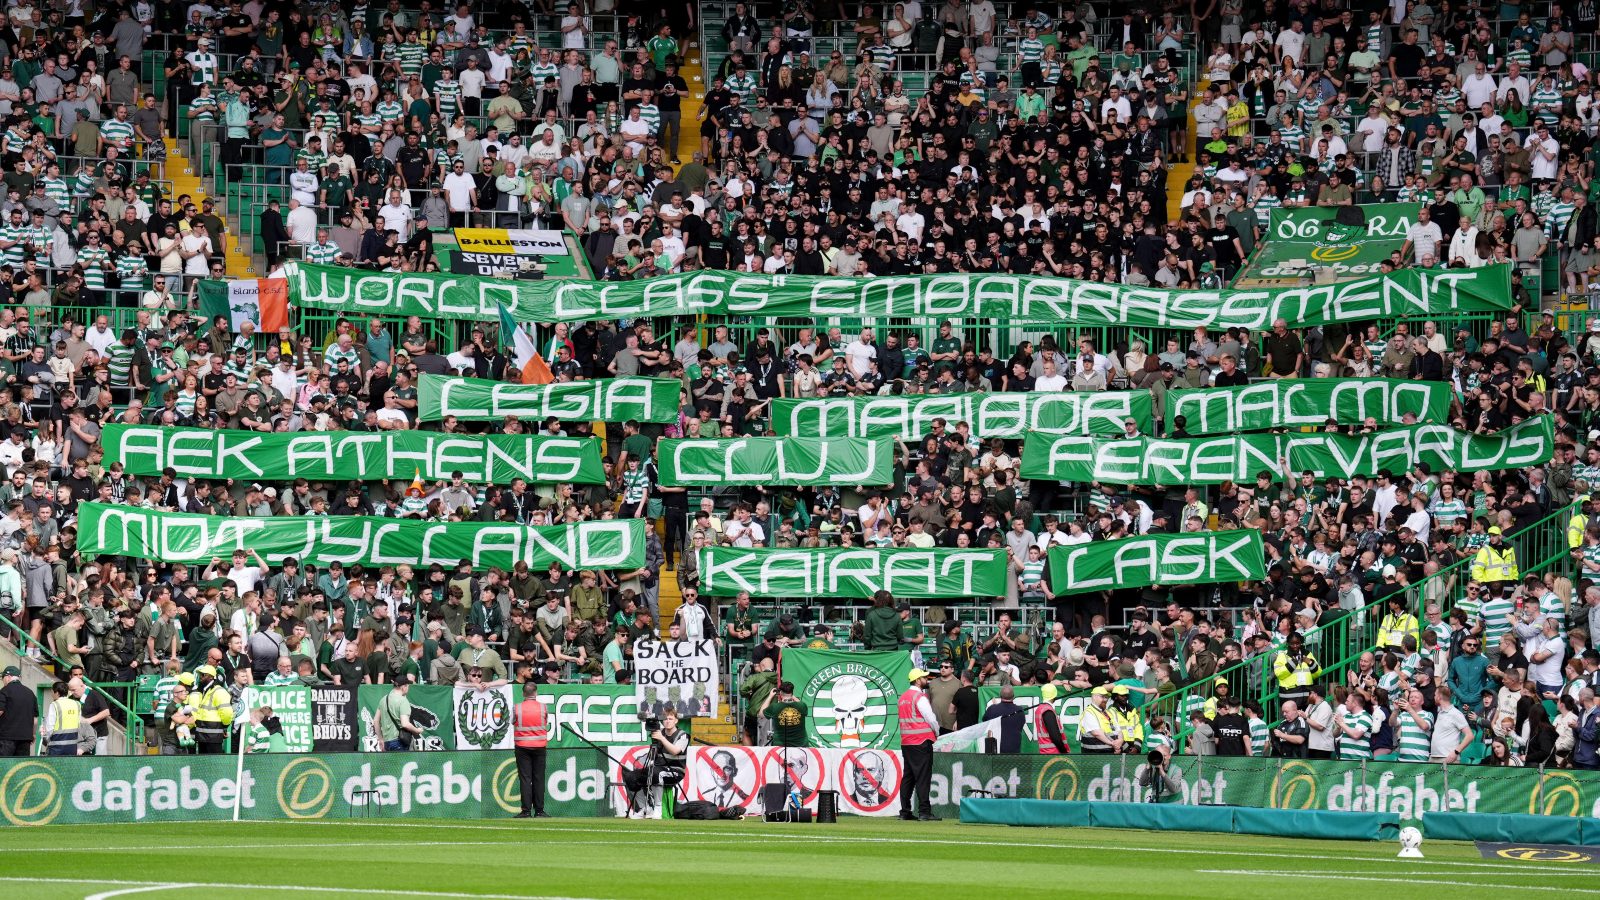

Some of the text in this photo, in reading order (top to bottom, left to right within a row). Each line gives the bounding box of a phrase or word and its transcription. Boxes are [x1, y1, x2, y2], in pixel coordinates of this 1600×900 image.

[460, 238, 562, 247] BAILLIESTON
[1277, 213, 1319, 239] ÓG
[555, 275, 785, 316] CLASS"
[811, 272, 1477, 328] EMBARRASSMENT
[440, 380, 652, 420] LEGIA
[791, 395, 1130, 438] MARIBOR
[1175, 381, 1430, 432] MALMO
[119, 428, 581, 480] AEK ATHENS
[674, 439, 876, 482] CLUJ
[1048, 418, 1546, 483] FERENCVAROS
[705, 550, 994, 596] KAIRAT
[1067, 535, 1252, 589] LASK
[637, 640, 710, 659] SACK
[664, 660, 684, 668] THE
[311, 689, 350, 702] BANNED
[638, 667, 711, 684] BOARD
[806, 663, 895, 698] GREEN BRIGADE
[249, 687, 307, 710] POLICE
[313, 725, 351, 740] BHOYS
[71, 765, 256, 819] dafabet
[1327, 770, 1481, 821] dafabet
